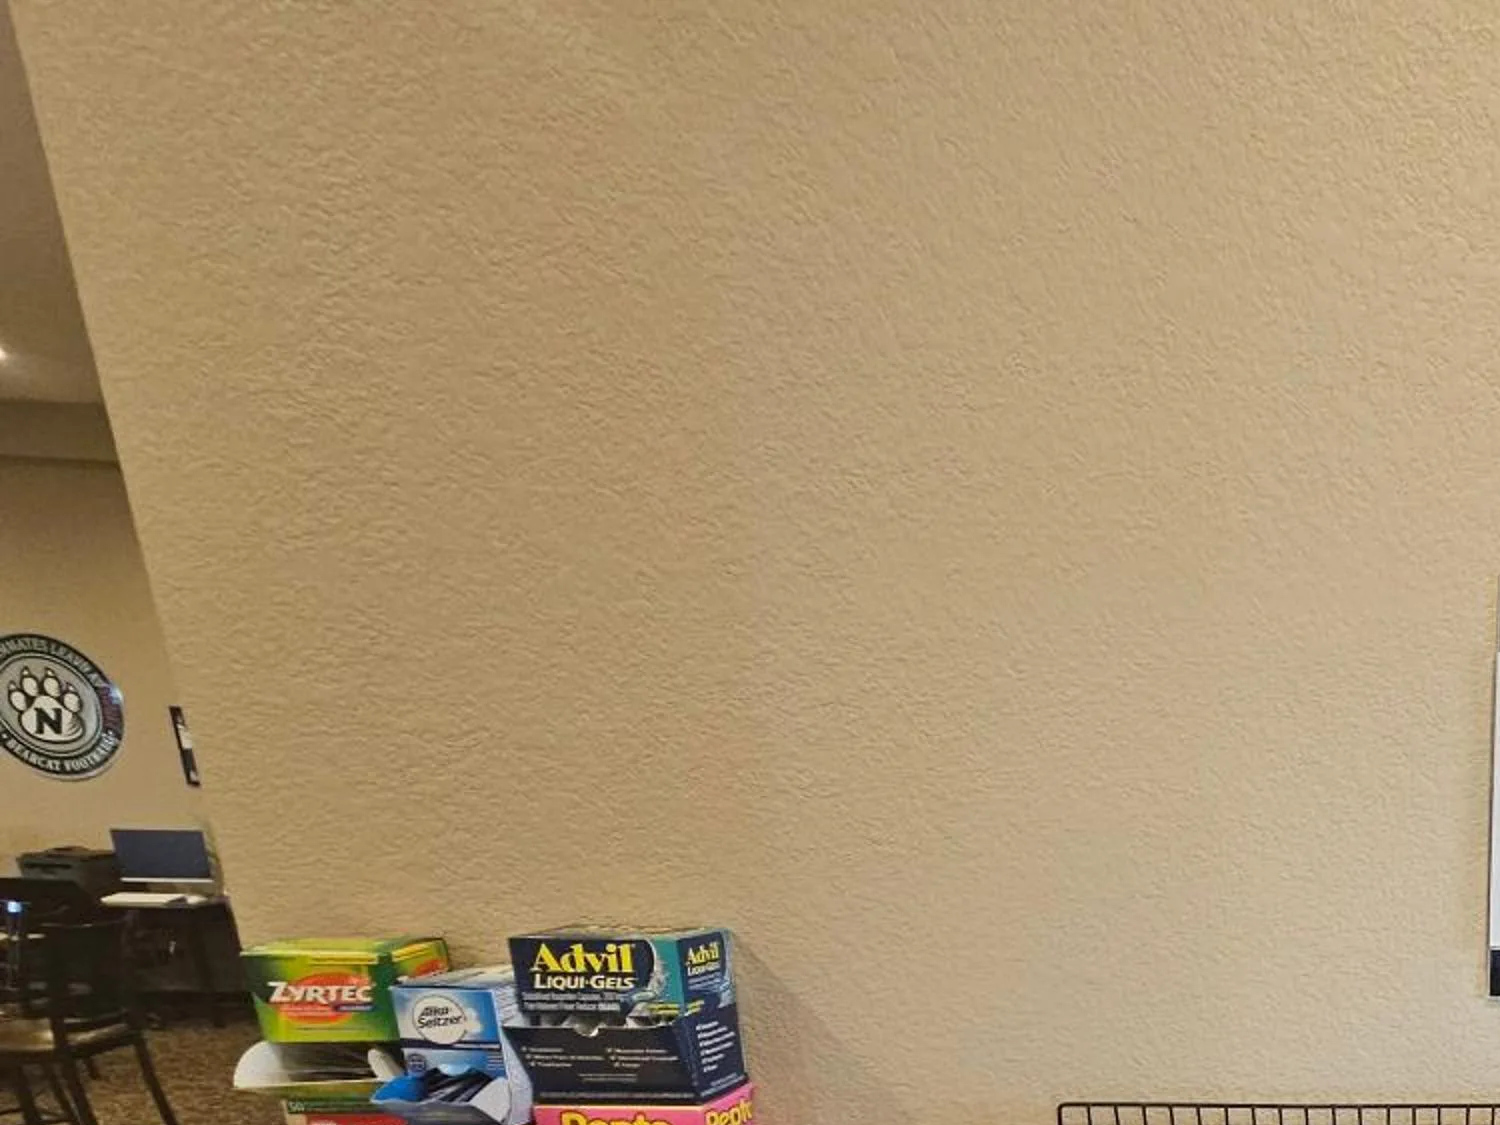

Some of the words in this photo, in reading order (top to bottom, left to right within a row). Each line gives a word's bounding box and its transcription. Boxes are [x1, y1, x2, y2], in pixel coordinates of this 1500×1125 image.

[34, 708, 62, 735] N
[530, 943, 636, 973] Advil
[686, 940, 721, 964] Advil
[267, 981, 375, 1004] ZYRTEC
